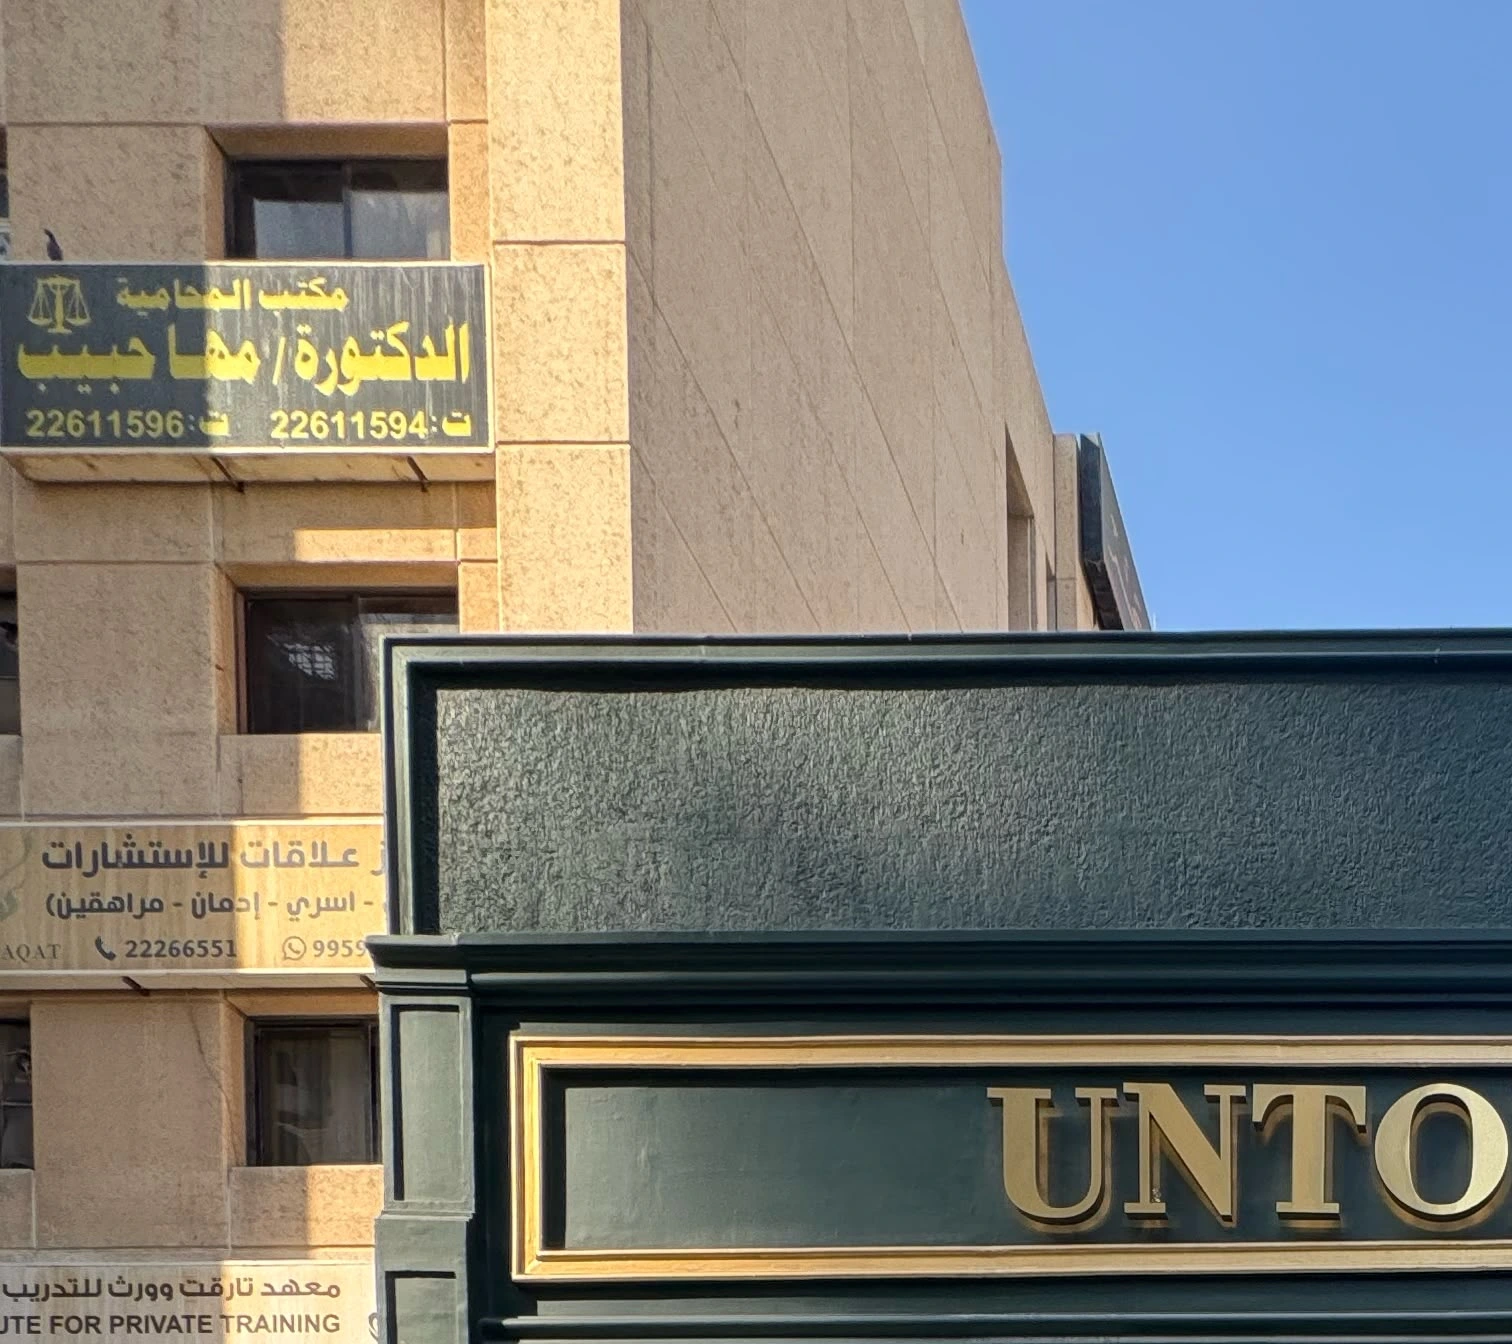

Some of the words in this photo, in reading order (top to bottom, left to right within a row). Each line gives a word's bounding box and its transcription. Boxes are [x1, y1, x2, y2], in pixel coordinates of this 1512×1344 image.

[116, 277, 252, 316] المحامية
[258, 277, 350, 315] مكتب
[17, 334, 156, 394] حبيب
[169, 323, 261, 384] مها
[42, 834, 229, 879] للإستشارات
[241, 839, 359, 868] علاقات
[191, 892, 260, 920] إدمان
[125, 939, 237, 958] 22266551
[2, 1278, 102, 1302] للتدريب
[108, 1275, 173, 1301] وورث
[180, 1276, 253, 1301] تارقت
[260, 1278, 341, 1299] معهد
[50, 1315, 102, 1334] FOR
[110, 1315, 213, 1334] PRIVATE
[220, 1314, 341, 1333] TRAINING
